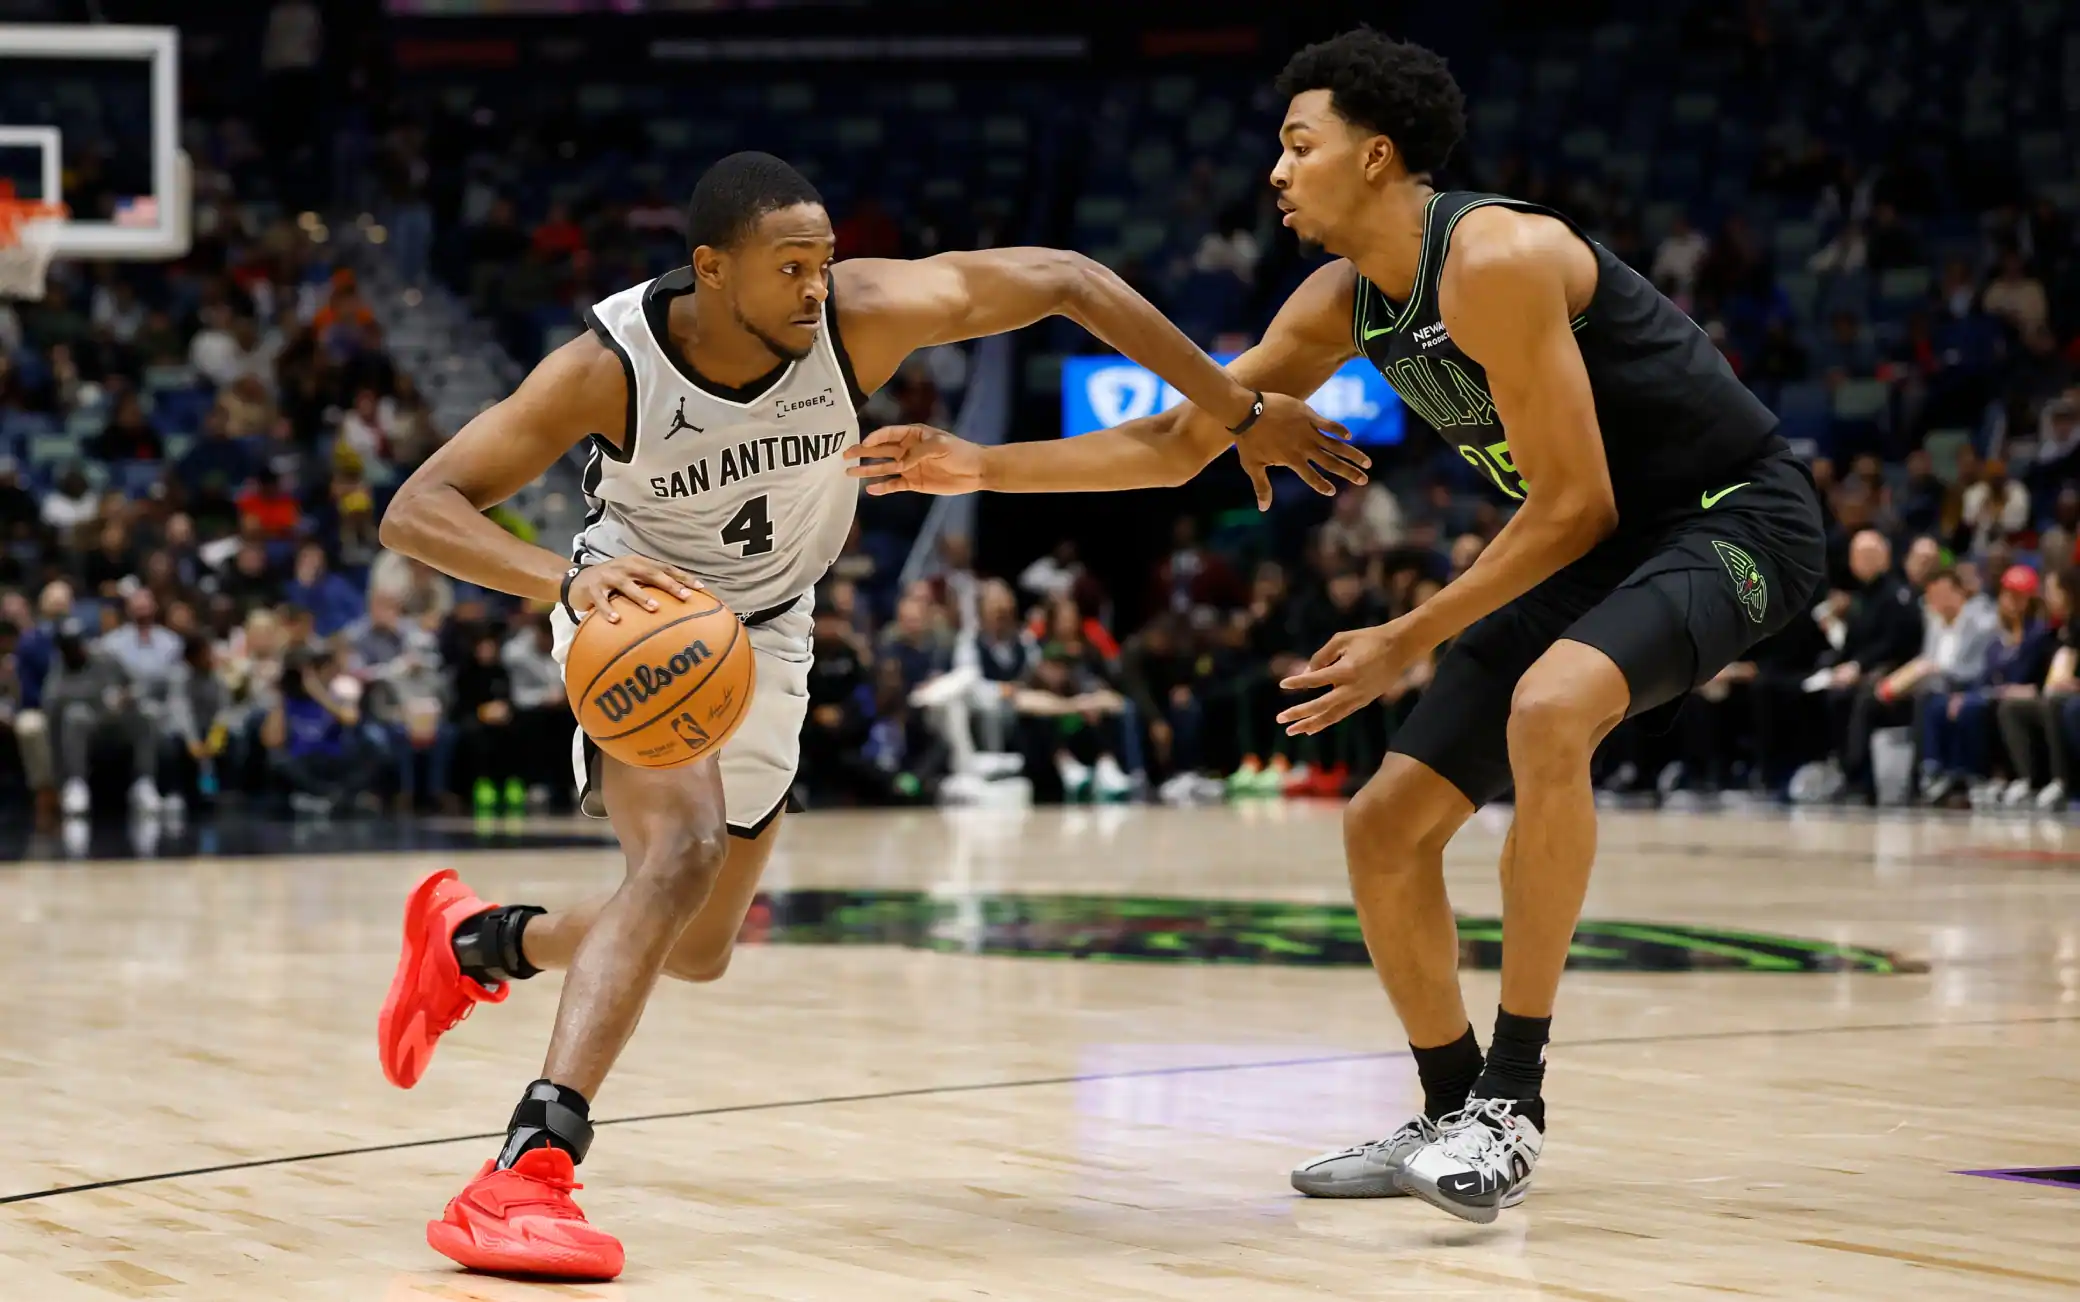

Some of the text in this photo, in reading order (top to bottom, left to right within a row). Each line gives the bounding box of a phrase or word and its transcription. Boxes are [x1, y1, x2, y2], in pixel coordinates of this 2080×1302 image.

[783, 395, 826, 412] LEDGER
[650, 430, 847, 499] SAN ANTONIO
[719, 493, 774, 558] 4
[593, 639, 713, 723] Wilson
